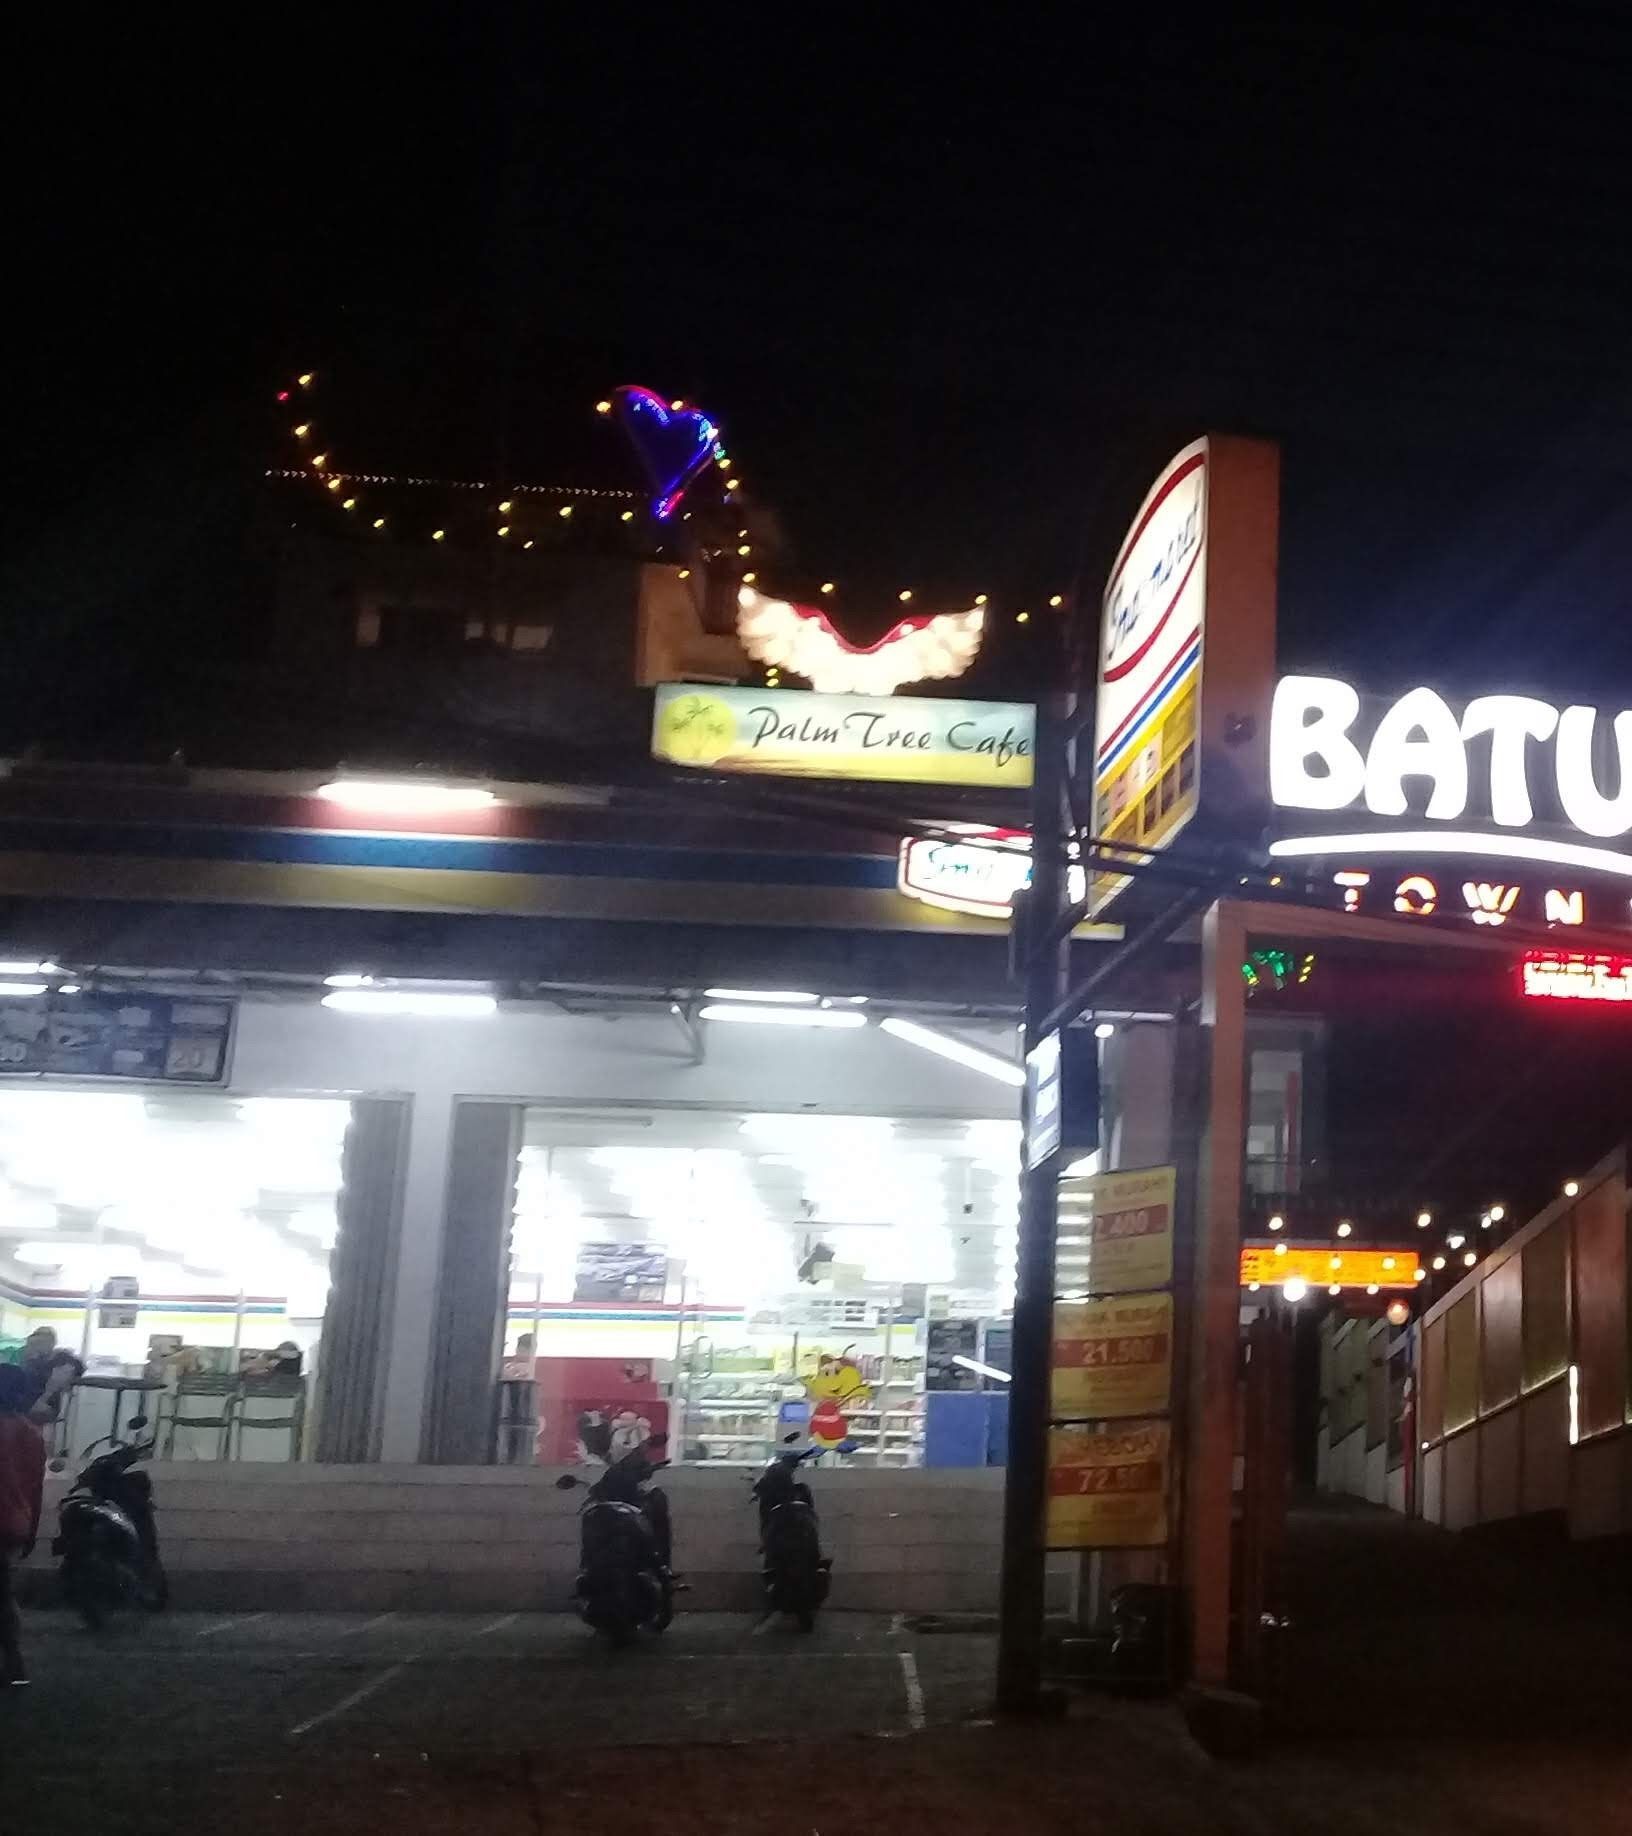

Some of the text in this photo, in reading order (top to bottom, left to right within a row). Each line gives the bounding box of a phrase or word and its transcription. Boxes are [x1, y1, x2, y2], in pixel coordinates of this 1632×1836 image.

[748, 706, 1031, 768] Palm Tree Cafe
[1333, 871, 1584, 927] TOWN
